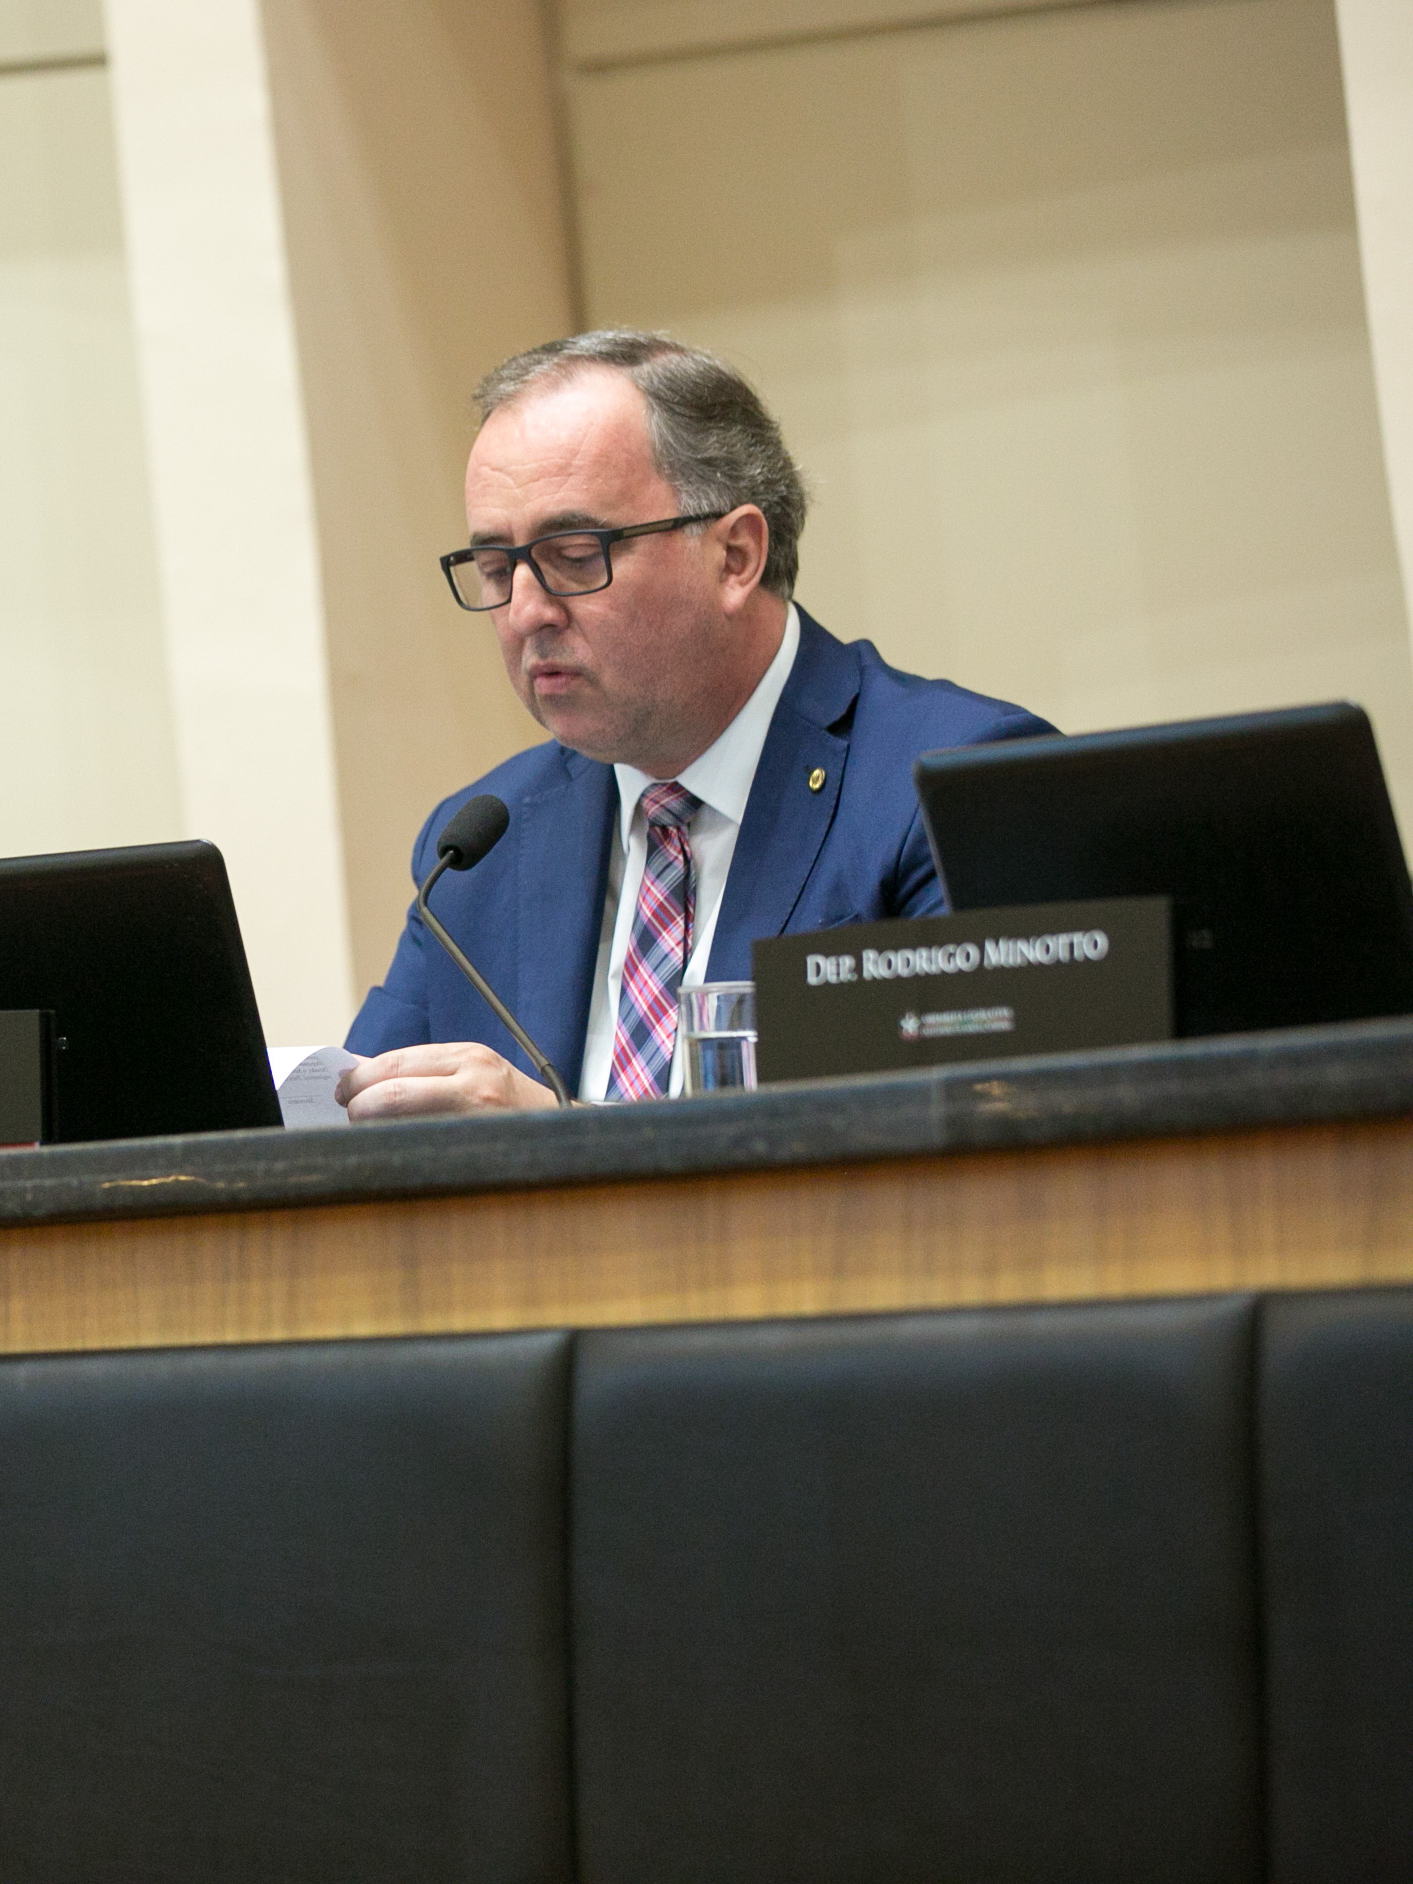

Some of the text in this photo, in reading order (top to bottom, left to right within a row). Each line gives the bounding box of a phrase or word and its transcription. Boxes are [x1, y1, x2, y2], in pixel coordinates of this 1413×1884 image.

[806, 928, 1110, 986] DEP. RODRIGO MINOTTO
